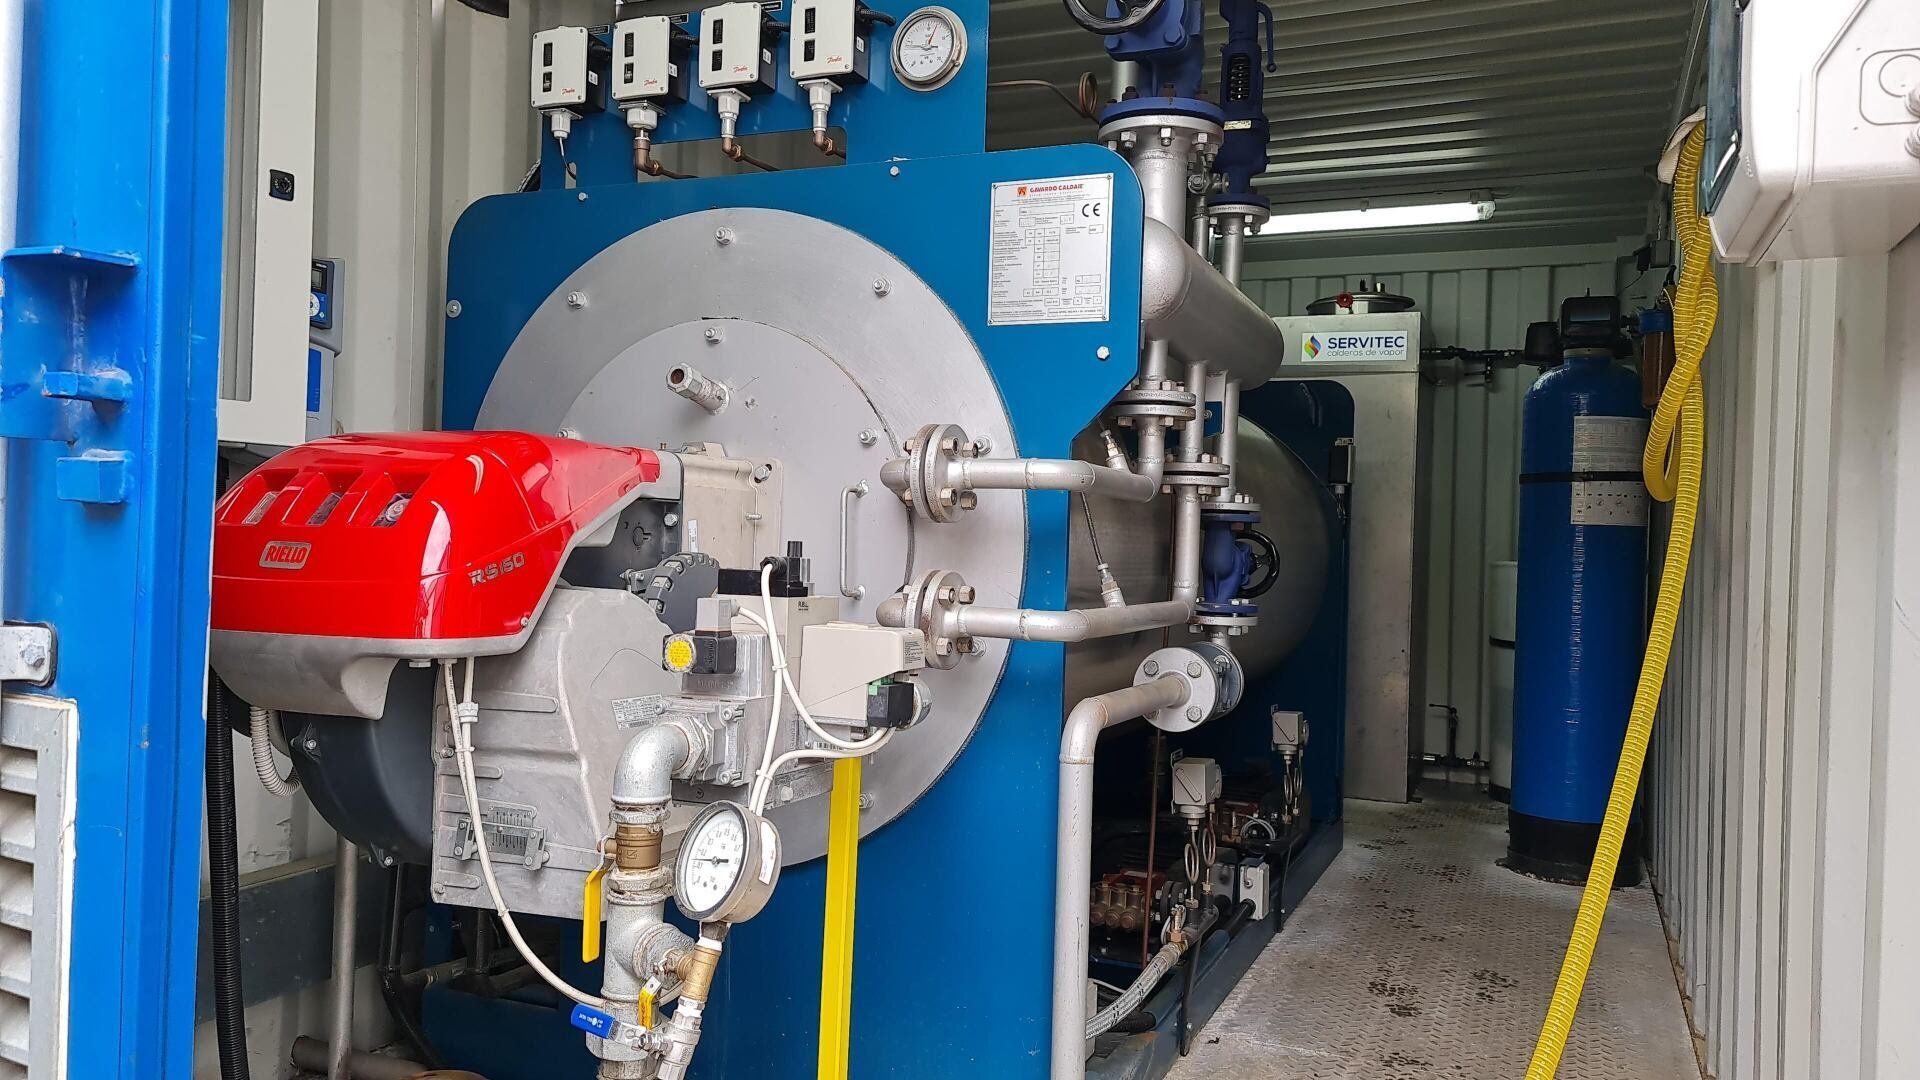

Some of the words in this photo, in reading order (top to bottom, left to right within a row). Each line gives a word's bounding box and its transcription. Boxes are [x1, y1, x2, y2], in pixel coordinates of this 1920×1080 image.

[1327, 336, 1405, 349] SERVITEC
[1327, 348, 1363, 357] calderas
[1366, 348, 1377, 356] de
[1379, 349, 1405, 358] vapor
[265, 545, 307, 564] RIELLO
